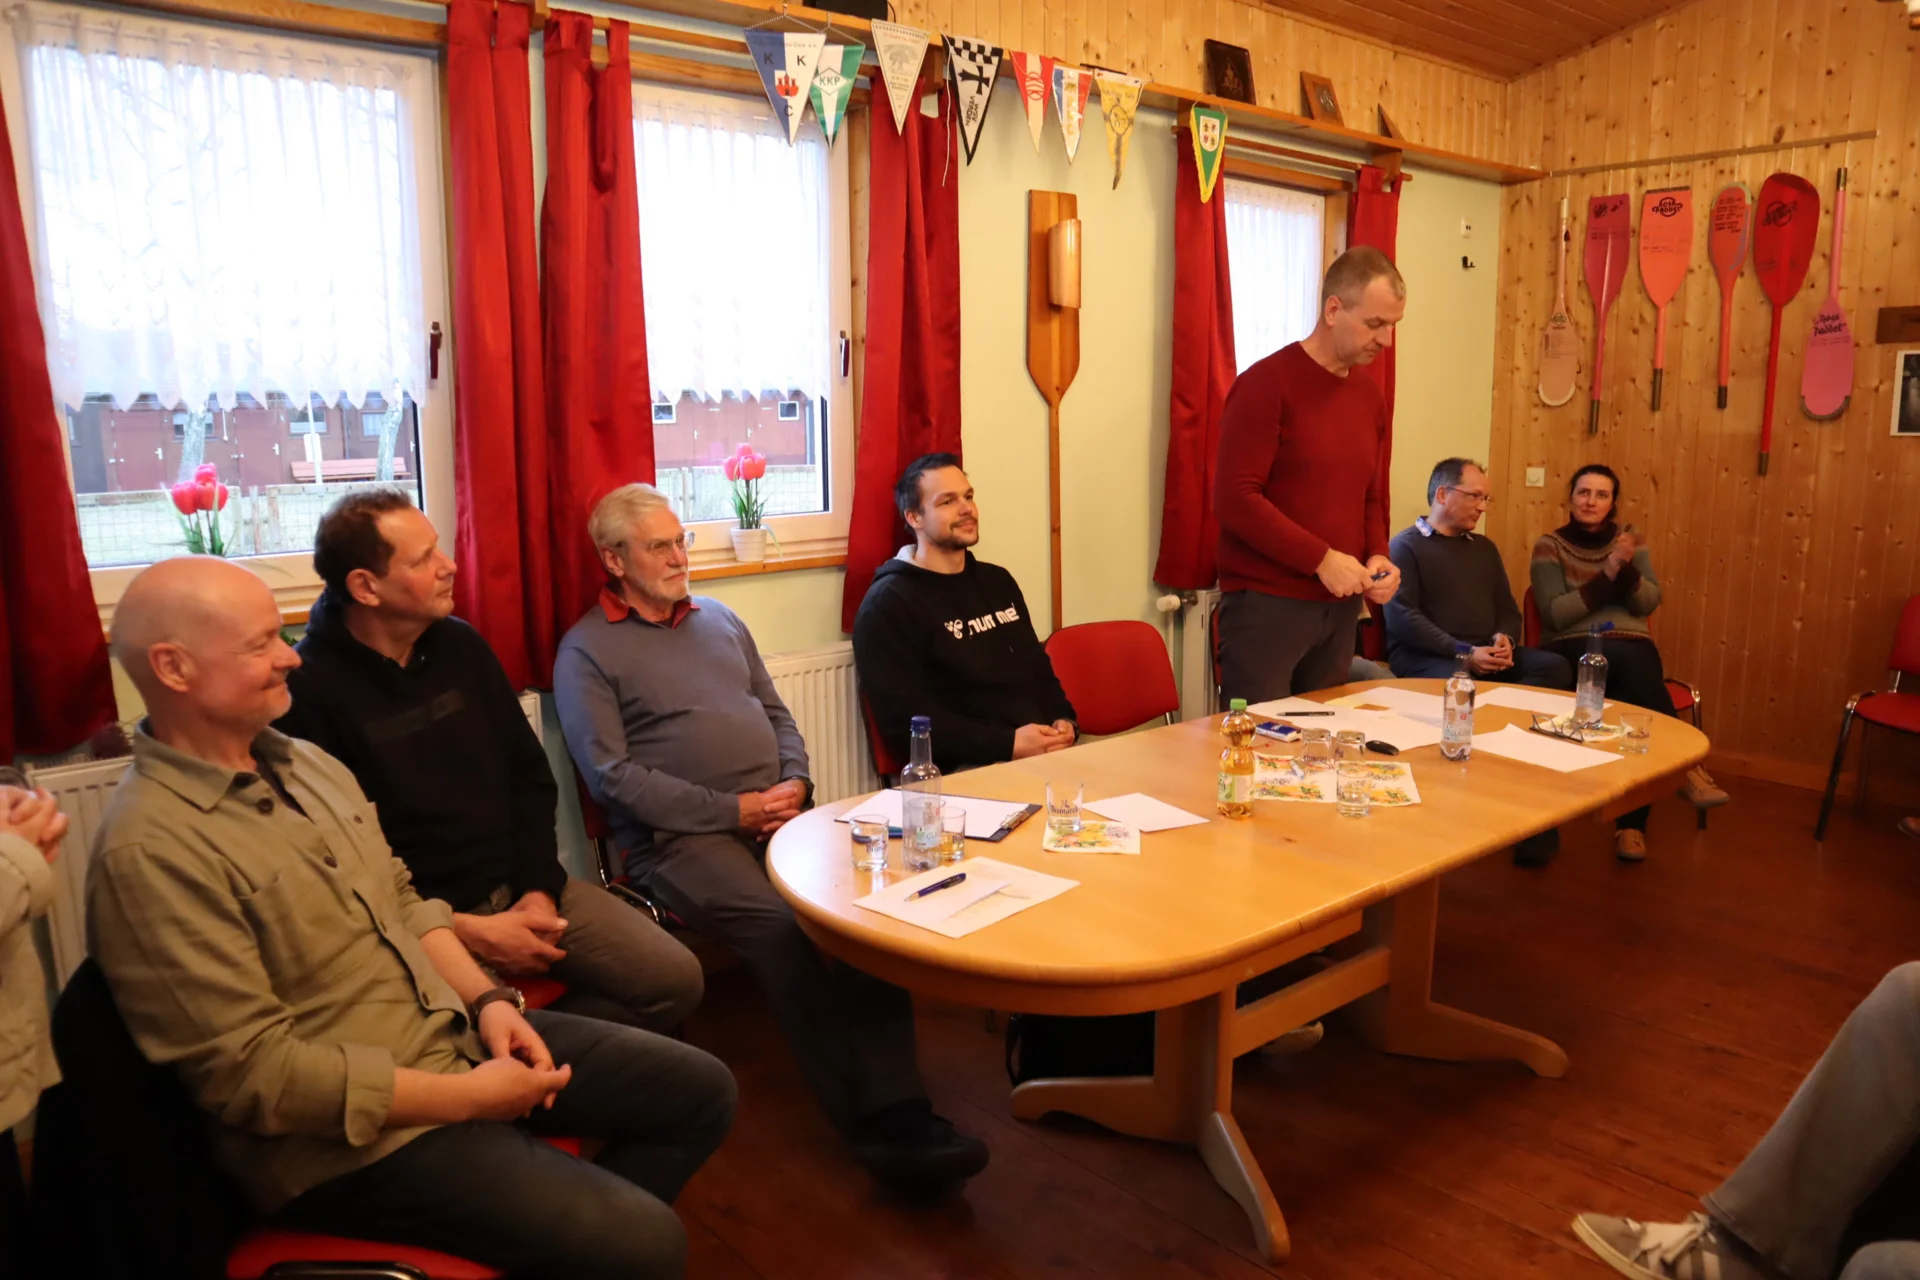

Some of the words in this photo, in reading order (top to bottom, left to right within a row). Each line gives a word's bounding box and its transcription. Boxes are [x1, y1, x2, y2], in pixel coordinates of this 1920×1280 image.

[763, 52, 774, 65] K
[796, 55, 807, 67] K
[819, 76, 840, 86] KKP
[783, 105, 794, 117] C
[964, 95, 976, 127] VERDEN
